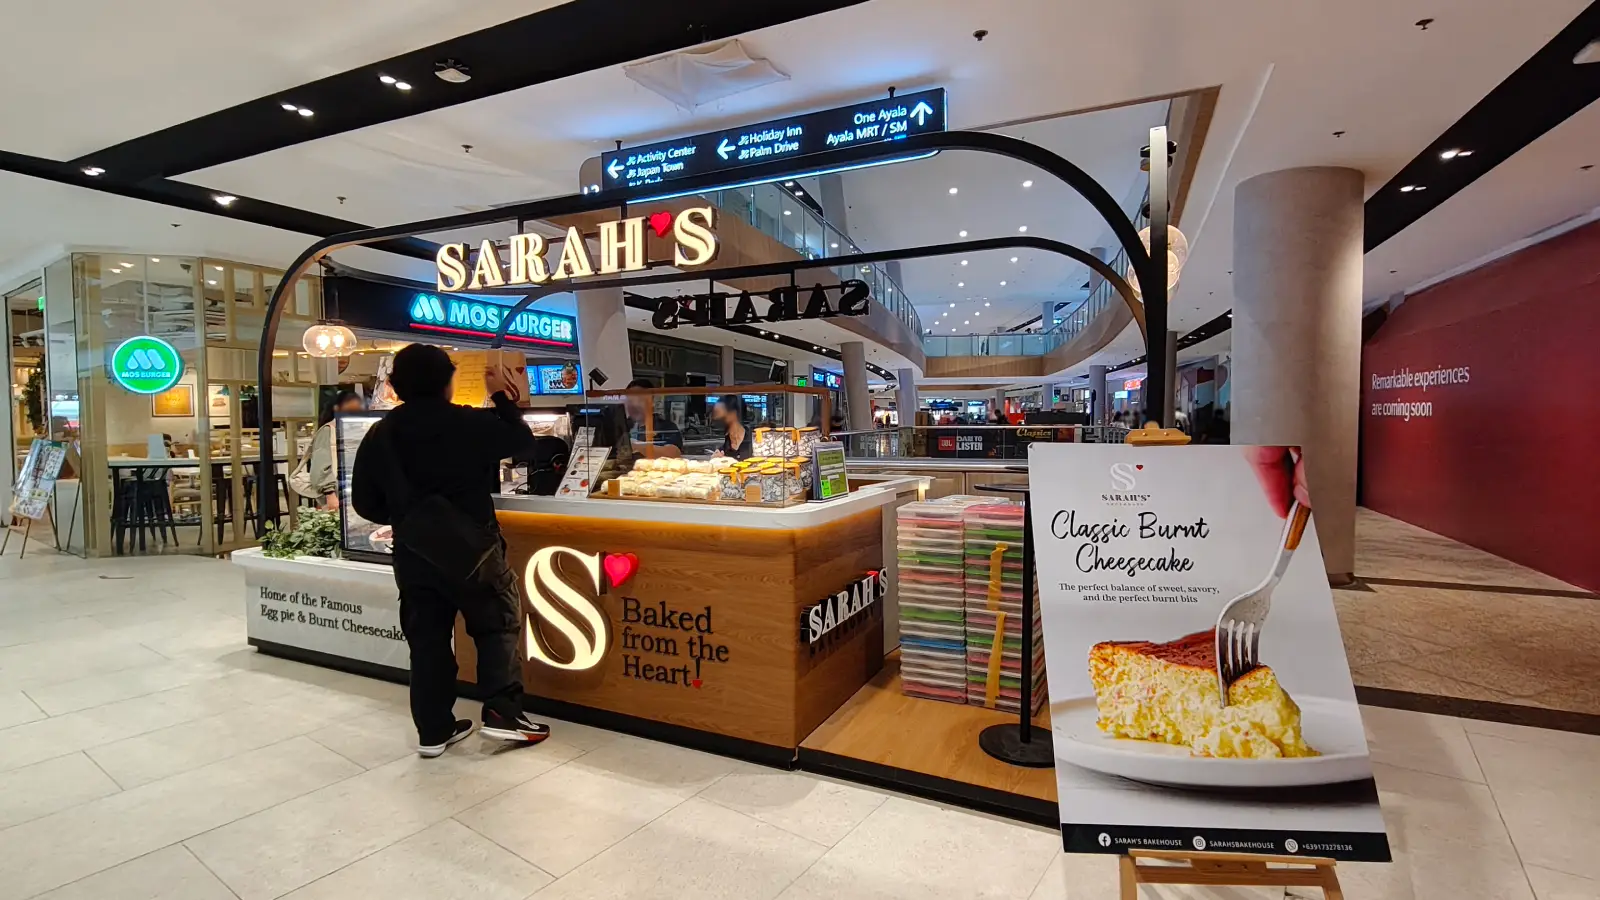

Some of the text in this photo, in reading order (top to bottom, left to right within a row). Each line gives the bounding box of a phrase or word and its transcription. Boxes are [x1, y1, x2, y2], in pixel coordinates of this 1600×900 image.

[854, 106, 907, 125] One Ayala
[749, 125, 803, 145] Holiday Inn
[826, 131, 854, 147] Ayala
[856, 124, 880, 139] MRT
[889, 120, 908, 134] SM
[636, 146, 697, 165] Activity Center
[749, 141, 799, 159] Palm Drive
[636, 161, 684, 179] Japan Town
[450, 302, 500, 330] MOS
[1372, 364, 1470, 392] Remarkable experiences
[1371, 397, 1432, 422] are coming soon
[956, 441, 983, 451] LISTEN
[1051, 509, 1210, 543] Classic Burnt
[1075, 542, 1194, 577] Cheesecake
[260, 586, 363, 615] Home of the Famous
[1059, 583, 1076, 591] The
[1077, 584, 1109, 592] perfect
[1110, 584, 1145, 592] balance
[1147, 584, 1156, 592] of
[1158, 585, 1187, 593] sweet,
[1118, 595, 1150, 603] perfect
[1151, 595, 1179, 603] burnt
[1180, 595, 1198, 603] bits
[261, 604, 278, 622] Egg
[280, 609, 295, 622] pie
[297, 610, 306, 624] &
[308, 612, 339, 630] Burnt
[524, 545, 608, 671] S
[621, 596, 714, 635] Baked
[622, 625, 729, 663] from the
[1114, 837, 1142, 846] SARAH'S
[1143, 838, 1183, 847] BAKEHOUSE
[1209, 840, 1275, 850] SARAHSBAKEHOUSE
